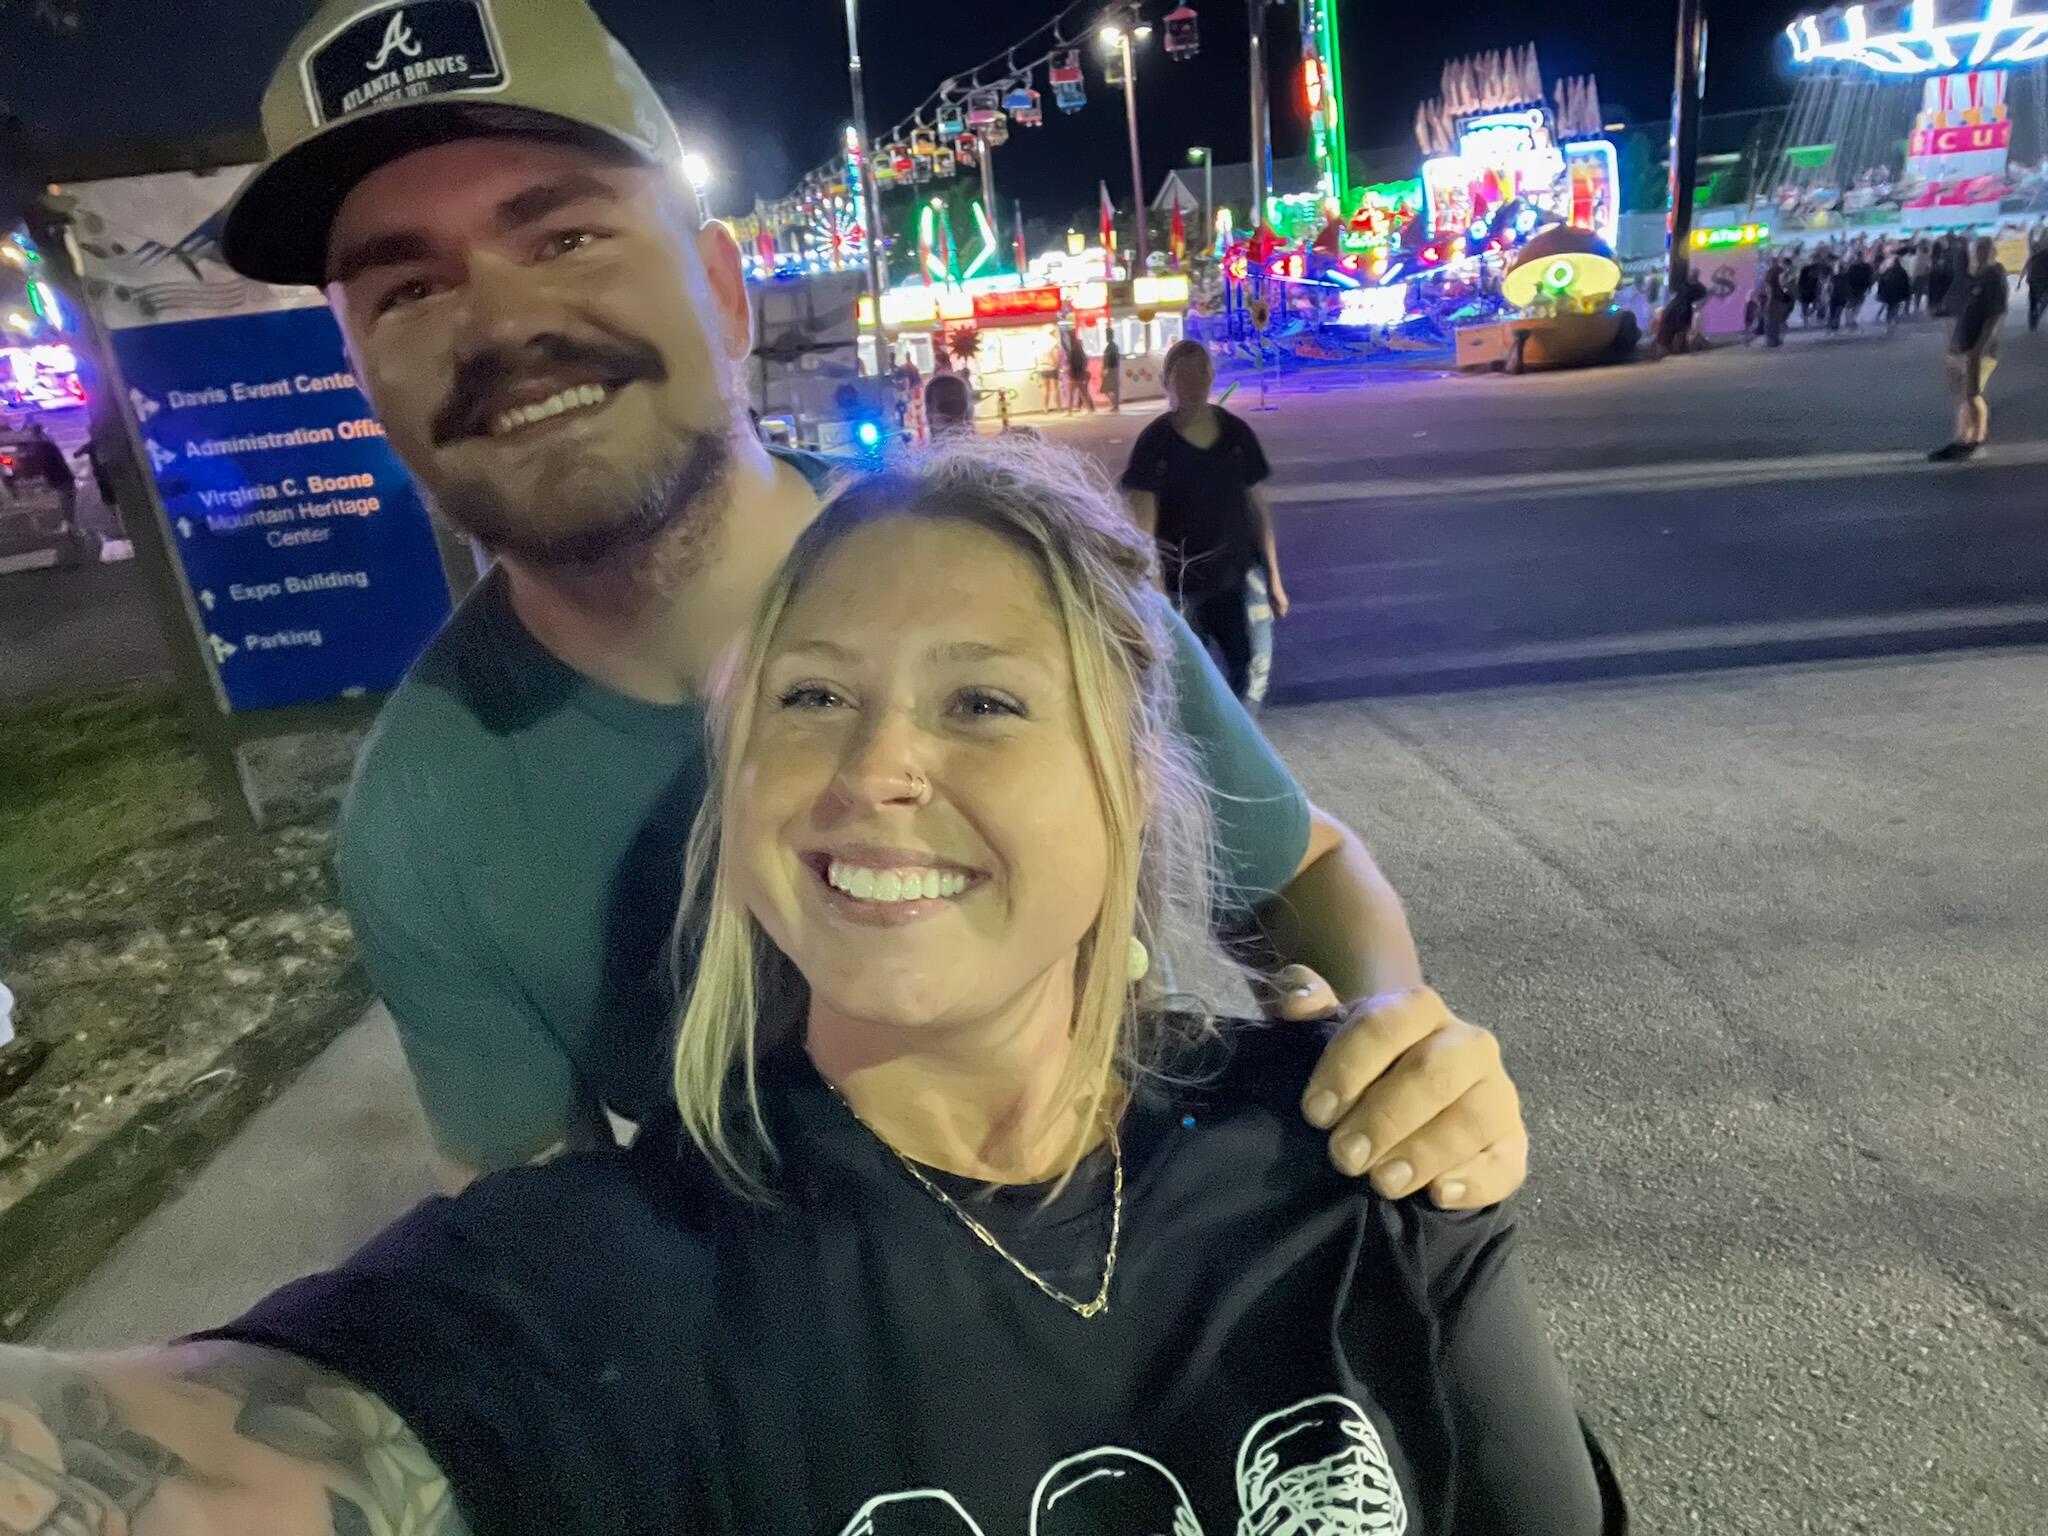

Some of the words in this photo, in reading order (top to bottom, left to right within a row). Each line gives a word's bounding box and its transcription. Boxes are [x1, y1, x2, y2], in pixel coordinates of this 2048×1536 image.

[365, 10, 422, 70] A
[343, 70, 400, 113] ATLANTA
[403, 54, 468, 83] BRAVES
[168, 387, 228, 409] Davis
[231, 379, 291, 401] Event
[295, 372, 355, 393] Cente
[186, 427, 334, 458] Administration
[337, 418, 386, 440] Offic
[198, 483, 278, 508] Virginia
[281, 478, 304, 497] C.
[307, 472, 374, 493] Boone
[206, 505, 295, 532] Mountain
[299, 496, 380, 517] Heritage
[266, 526, 331, 548] Center
[229, 583, 282, 601] Expo
[284, 572, 370, 594] Building
[245, 629, 323, 651] Parking
